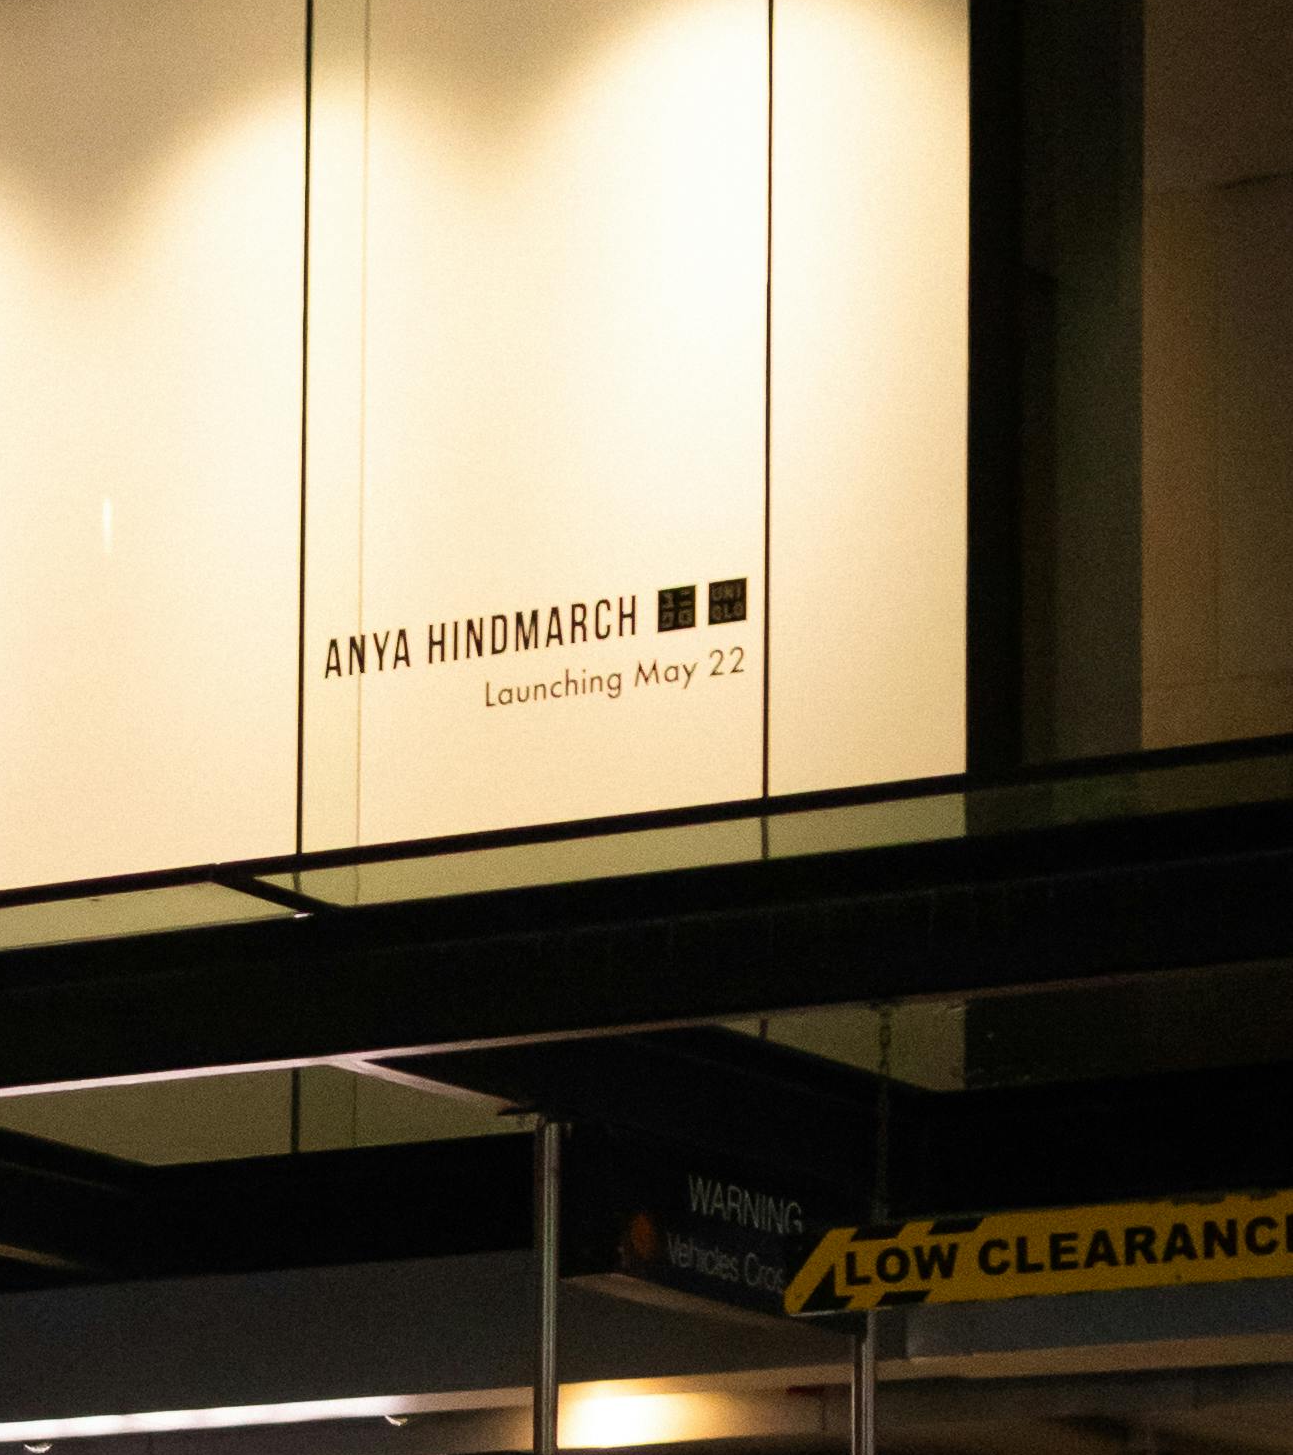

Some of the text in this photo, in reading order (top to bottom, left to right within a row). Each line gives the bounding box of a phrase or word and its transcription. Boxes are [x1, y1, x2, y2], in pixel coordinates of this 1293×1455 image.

[324, 594, 638, 679] ANYA HINDMARCH
[485, 646, 746, 707] Launching May 22
[686, 1172, 805, 1236] WARNING
[845, 1214, 1293, 1287] LOW CLEARANC
